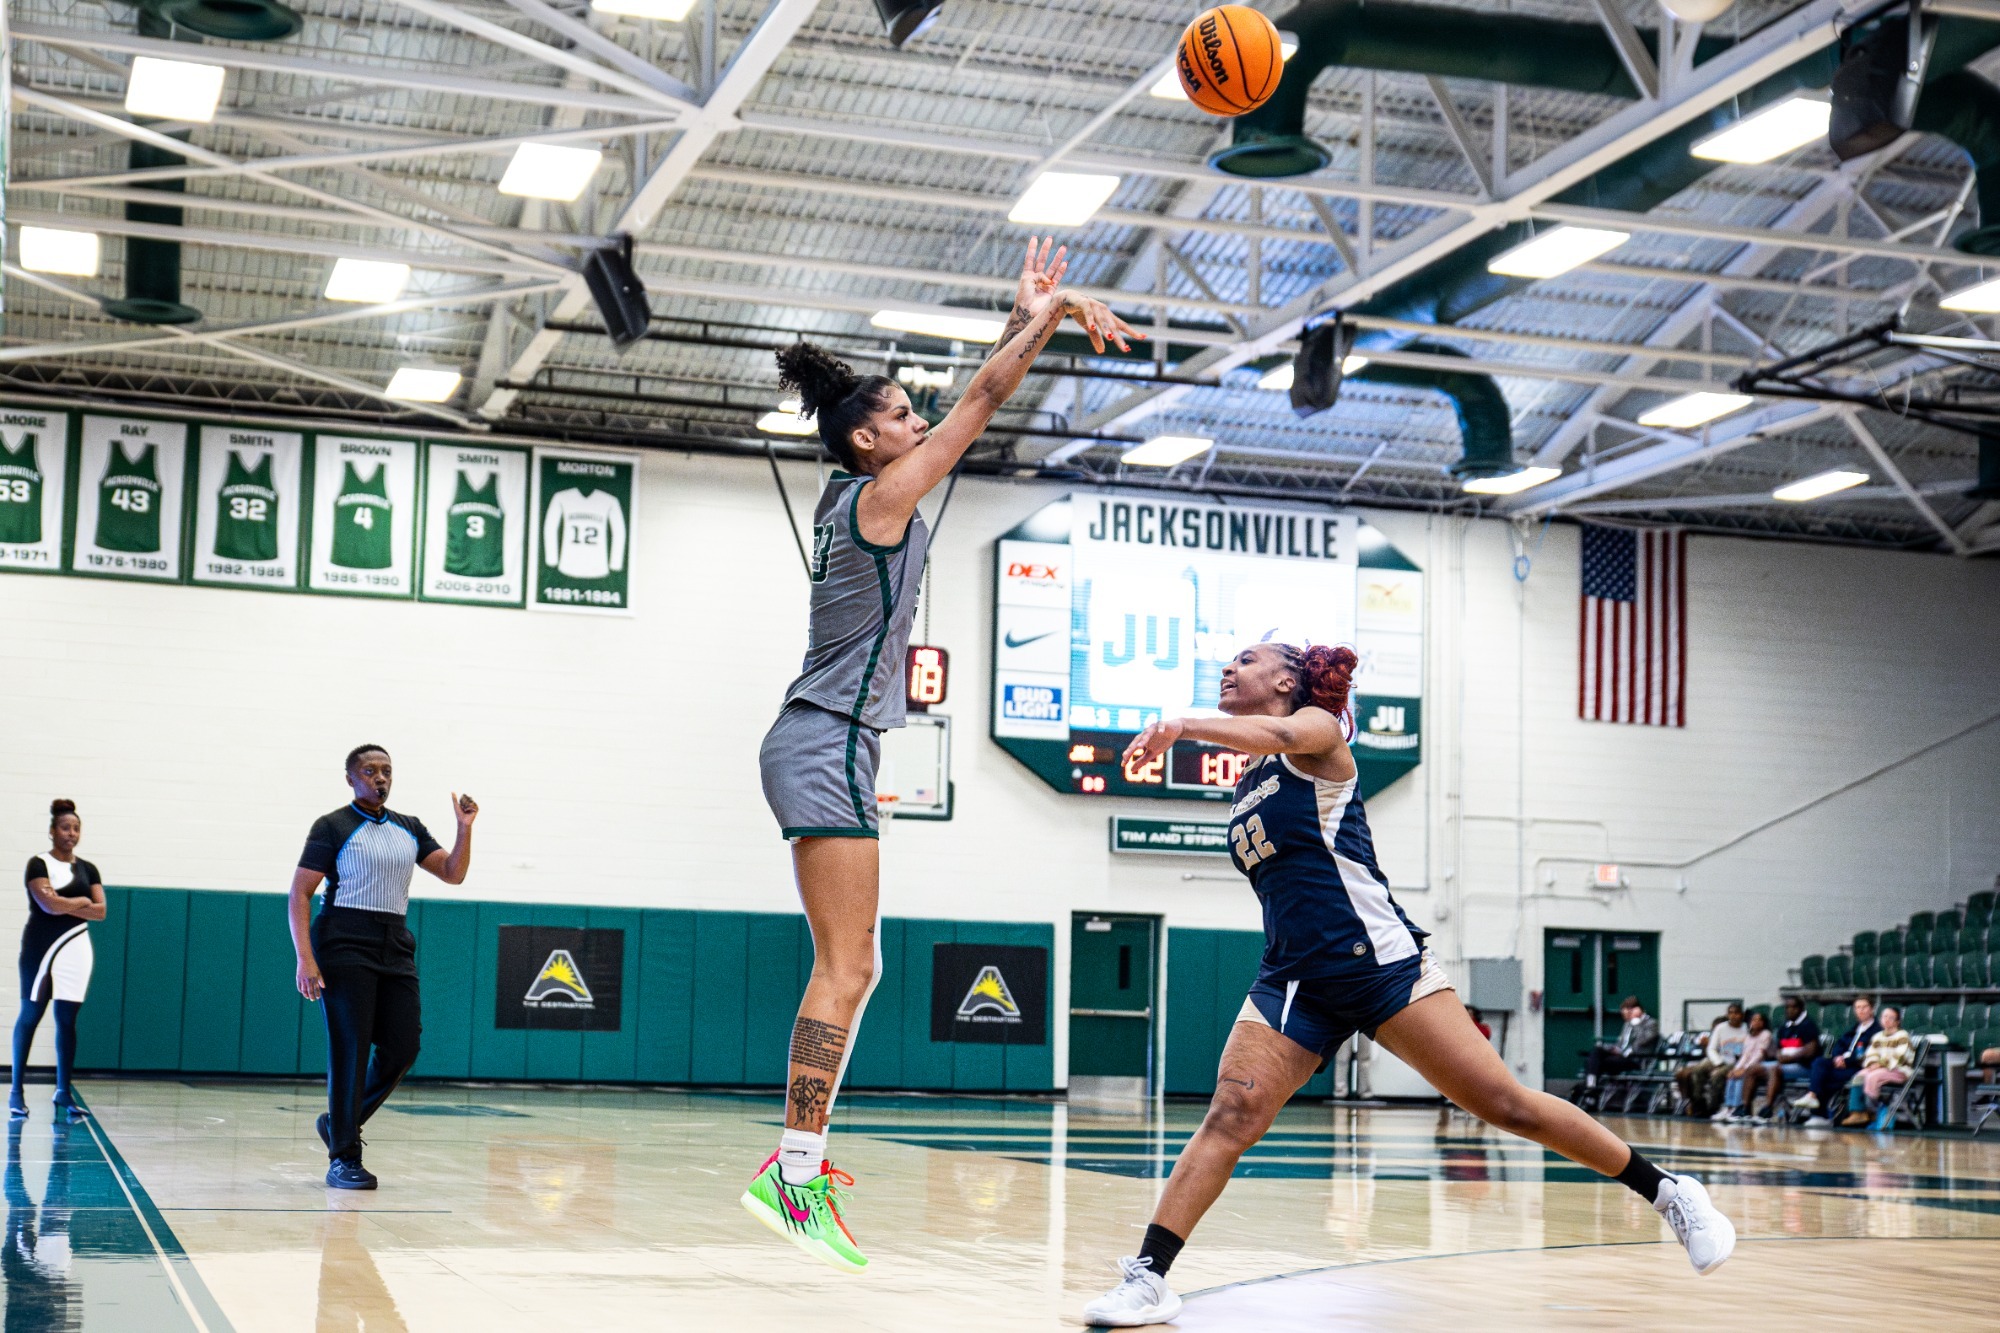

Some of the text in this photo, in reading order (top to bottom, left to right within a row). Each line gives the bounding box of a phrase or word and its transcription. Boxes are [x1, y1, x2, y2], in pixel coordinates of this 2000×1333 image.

[1199, 16, 1229, 86] Wilson
[119, 424, 149, 437] RAY
[229, 434, 274, 447] SMITH
[340, 443, 392, 456] BROWN
[457, 453, 500, 465] SMITH
[557, 462, 616, 477] MORTON
[111, 488, 151, 513] 43
[229, 497, 268, 521] 32
[353, 506, 374, 530] 4
[466, 515, 486, 539] 3
[571, 525, 599, 545] 12
[1088, 501, 1339, 560] JACKSONVILLE
[1007, 562, 1059, 580] DEX
[435, 580, 511, 595] 2006-2010
[1102, 613, 1181, 670] JU
[911, 664, 943, 703] 18
[1012, 686, 1054, 703] BUD
[1004, 700, 1061, 721] LIGHT
[1369, 706, 1405, 731] JU
[1120, 830, 1147, 843] TIM
[1148, 832, 1182, 845] AND
[1231, 813, 1277, 871] 22
